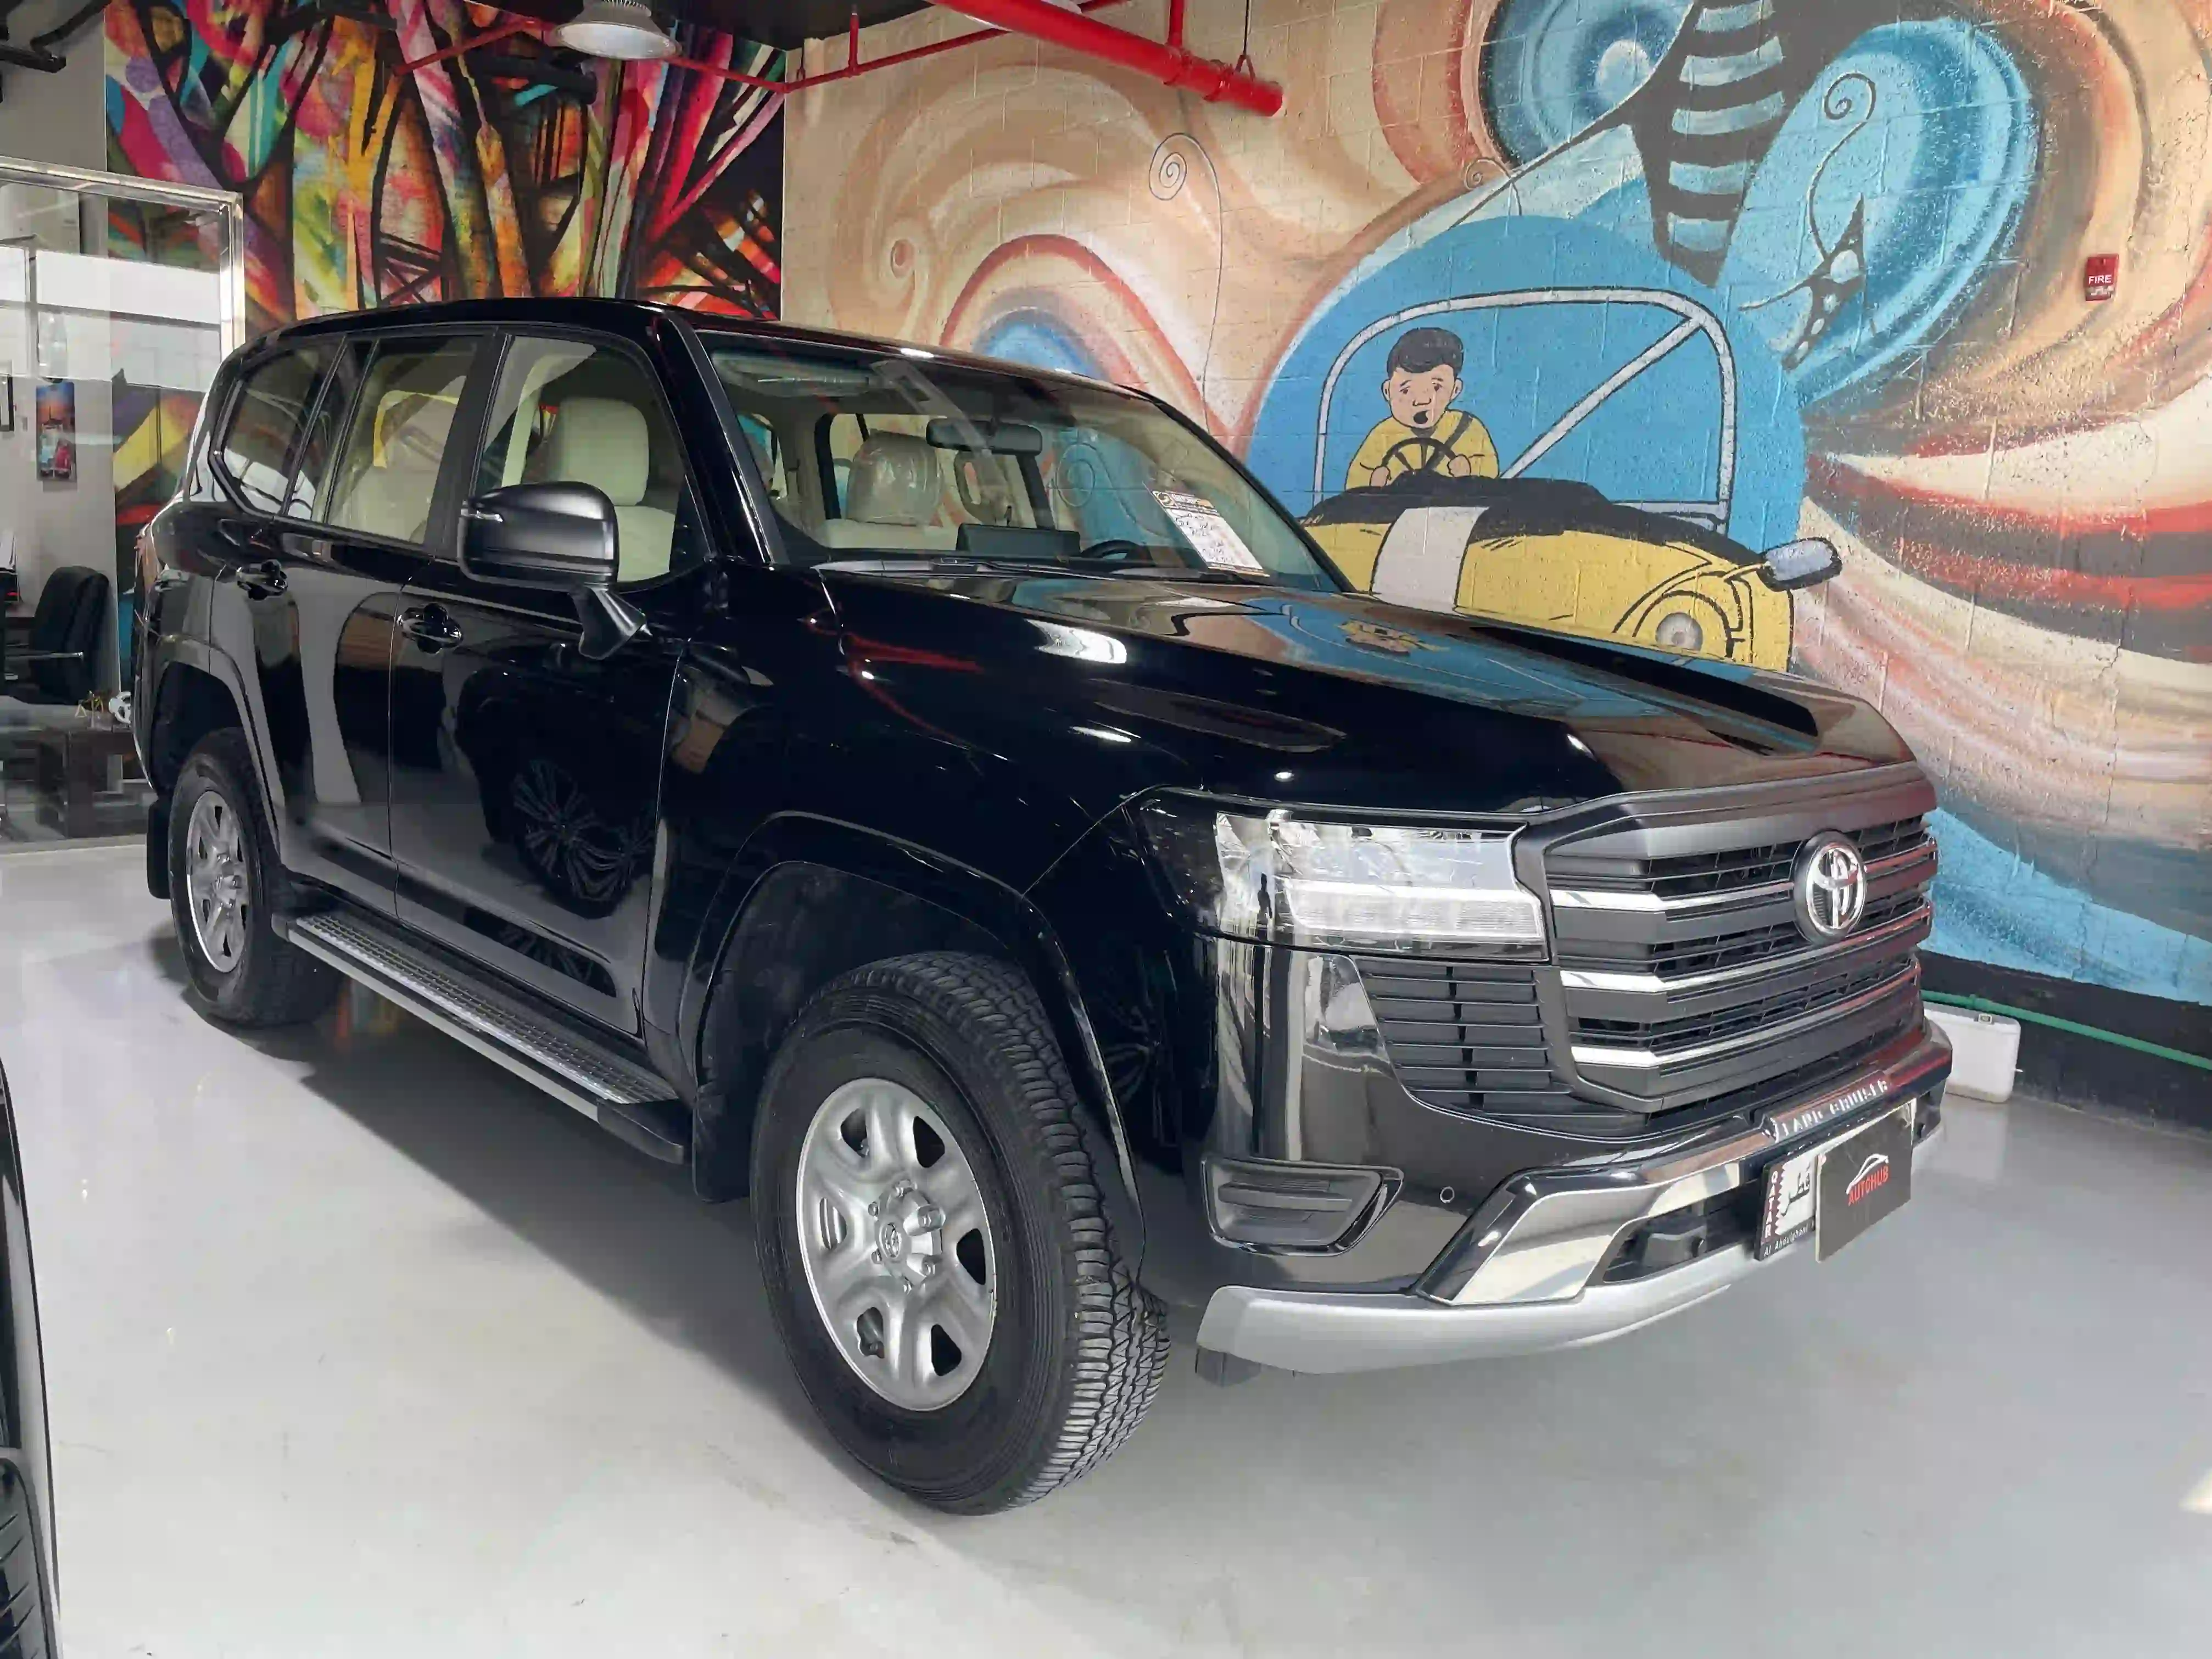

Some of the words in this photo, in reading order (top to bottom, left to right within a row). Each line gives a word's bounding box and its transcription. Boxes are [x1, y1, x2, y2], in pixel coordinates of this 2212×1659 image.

[2088, 274, 2112, 284] FIRE
[1764, 1170, 1779, 1239] QATAR
[1780, 1162, 1811, 1217] قطر
[1848, 1165, 1889, 1206] AUTOHUB
